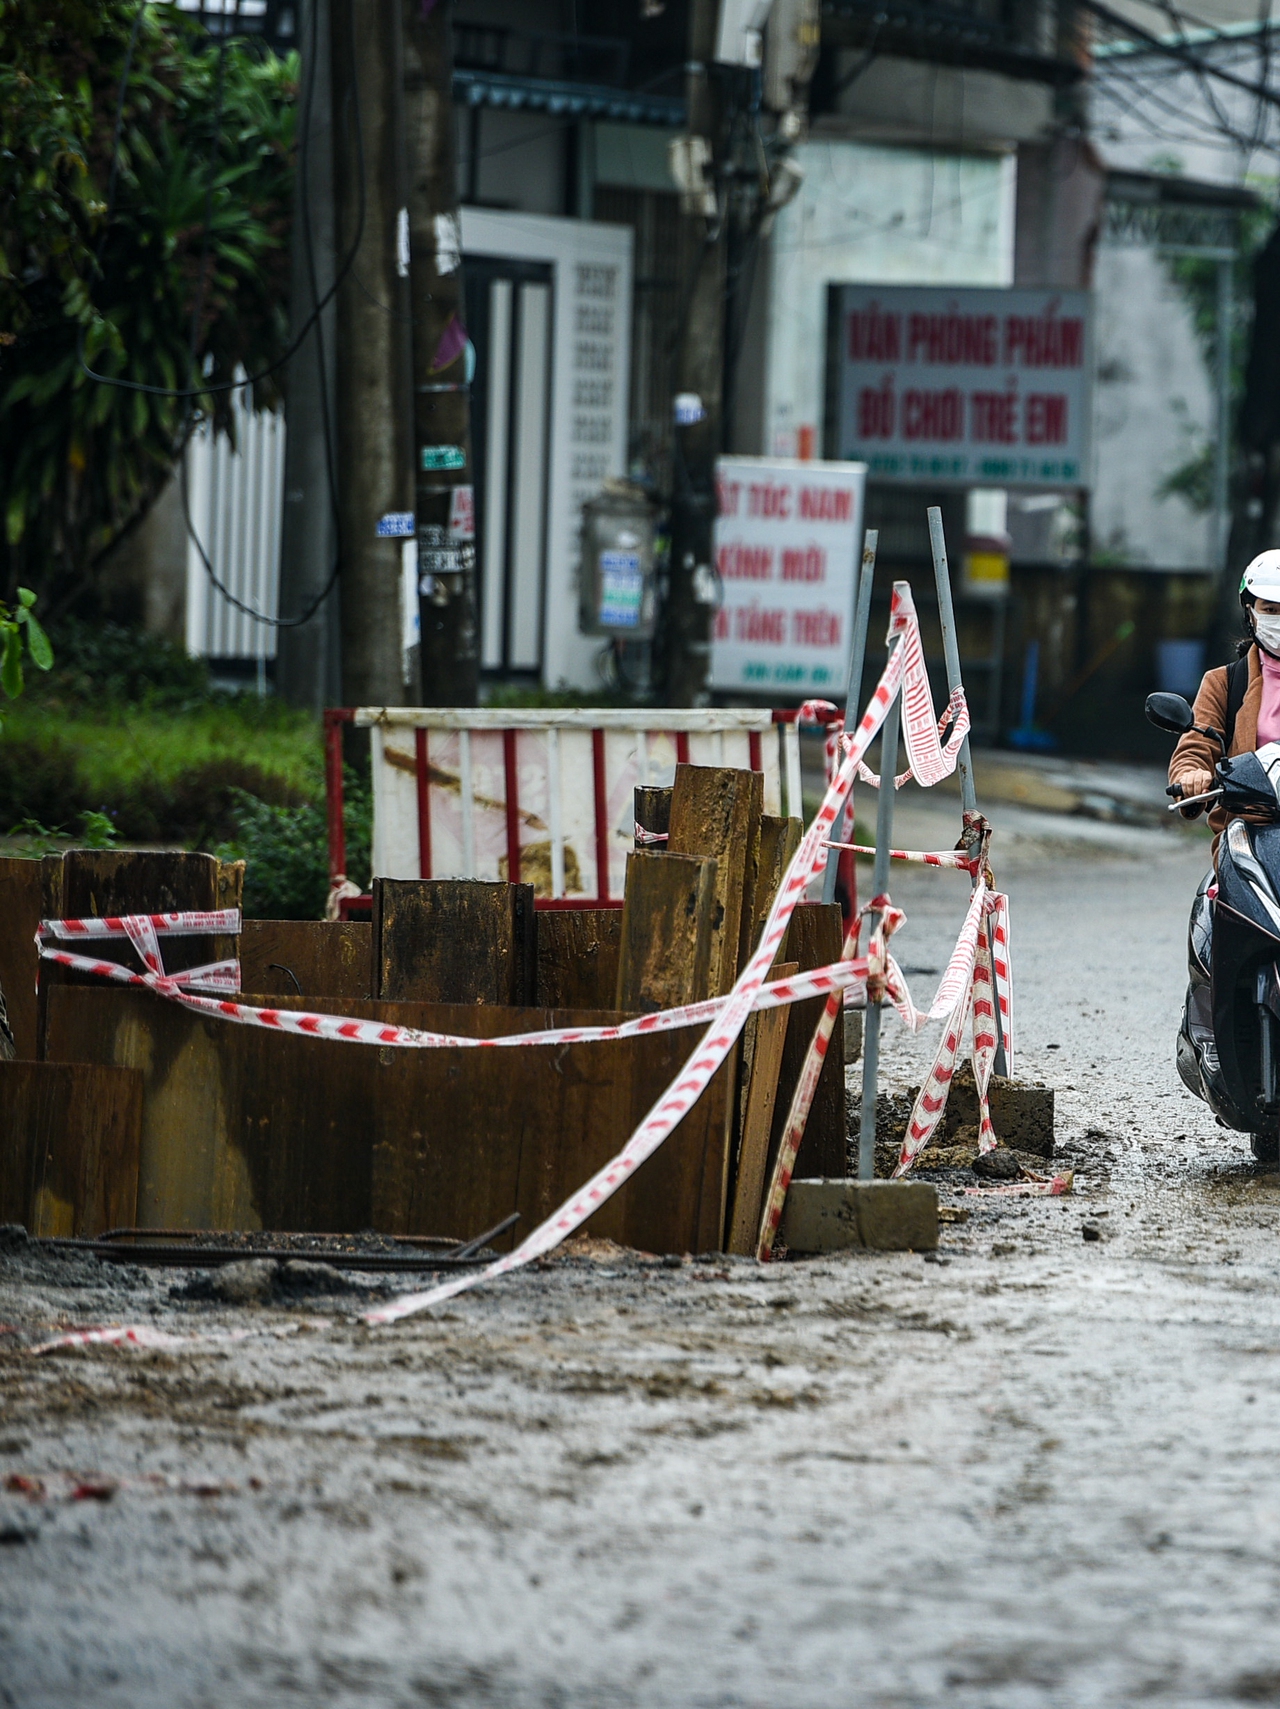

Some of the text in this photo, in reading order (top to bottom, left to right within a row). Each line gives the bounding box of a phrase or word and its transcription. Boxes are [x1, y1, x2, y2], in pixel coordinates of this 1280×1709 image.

[907, 301, 996, 367] PHÒNG
[971, 374, 1019, 445] TRẺ
[1025, 394, 1067, 446] EM
[800, 487, 852, 523] NAM
